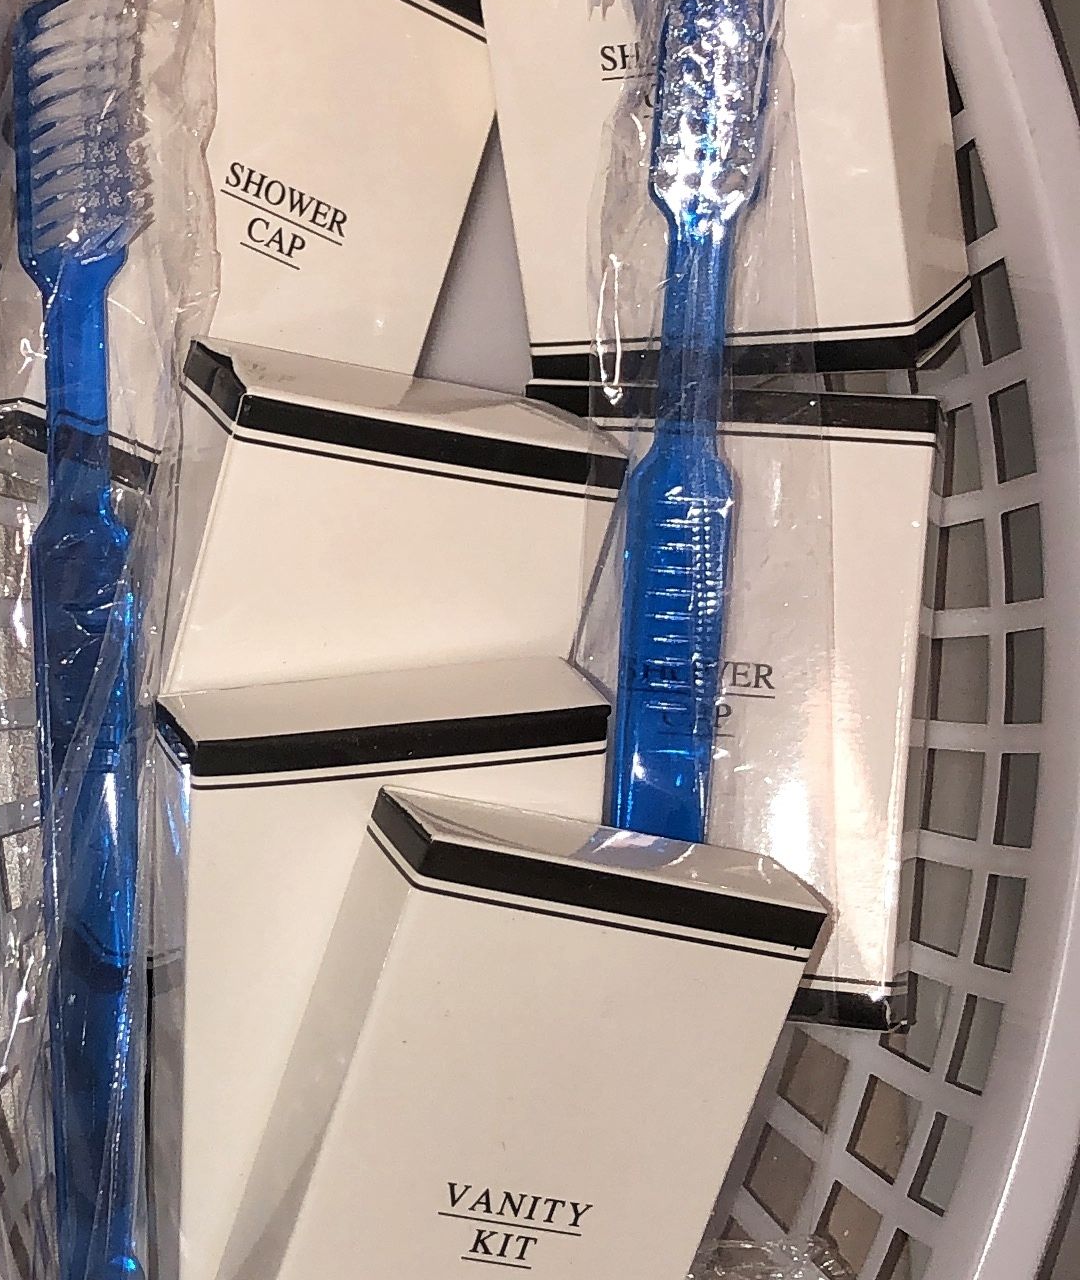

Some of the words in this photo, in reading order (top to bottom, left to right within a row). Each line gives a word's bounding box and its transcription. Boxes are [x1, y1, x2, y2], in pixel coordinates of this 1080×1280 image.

[224, 161, 348, 238] SHOWER
[246, 217, 306, 259] CAP
[446, 1181, 594, 1228] VANITY
[468, 1228, 538, 1261] KIT
